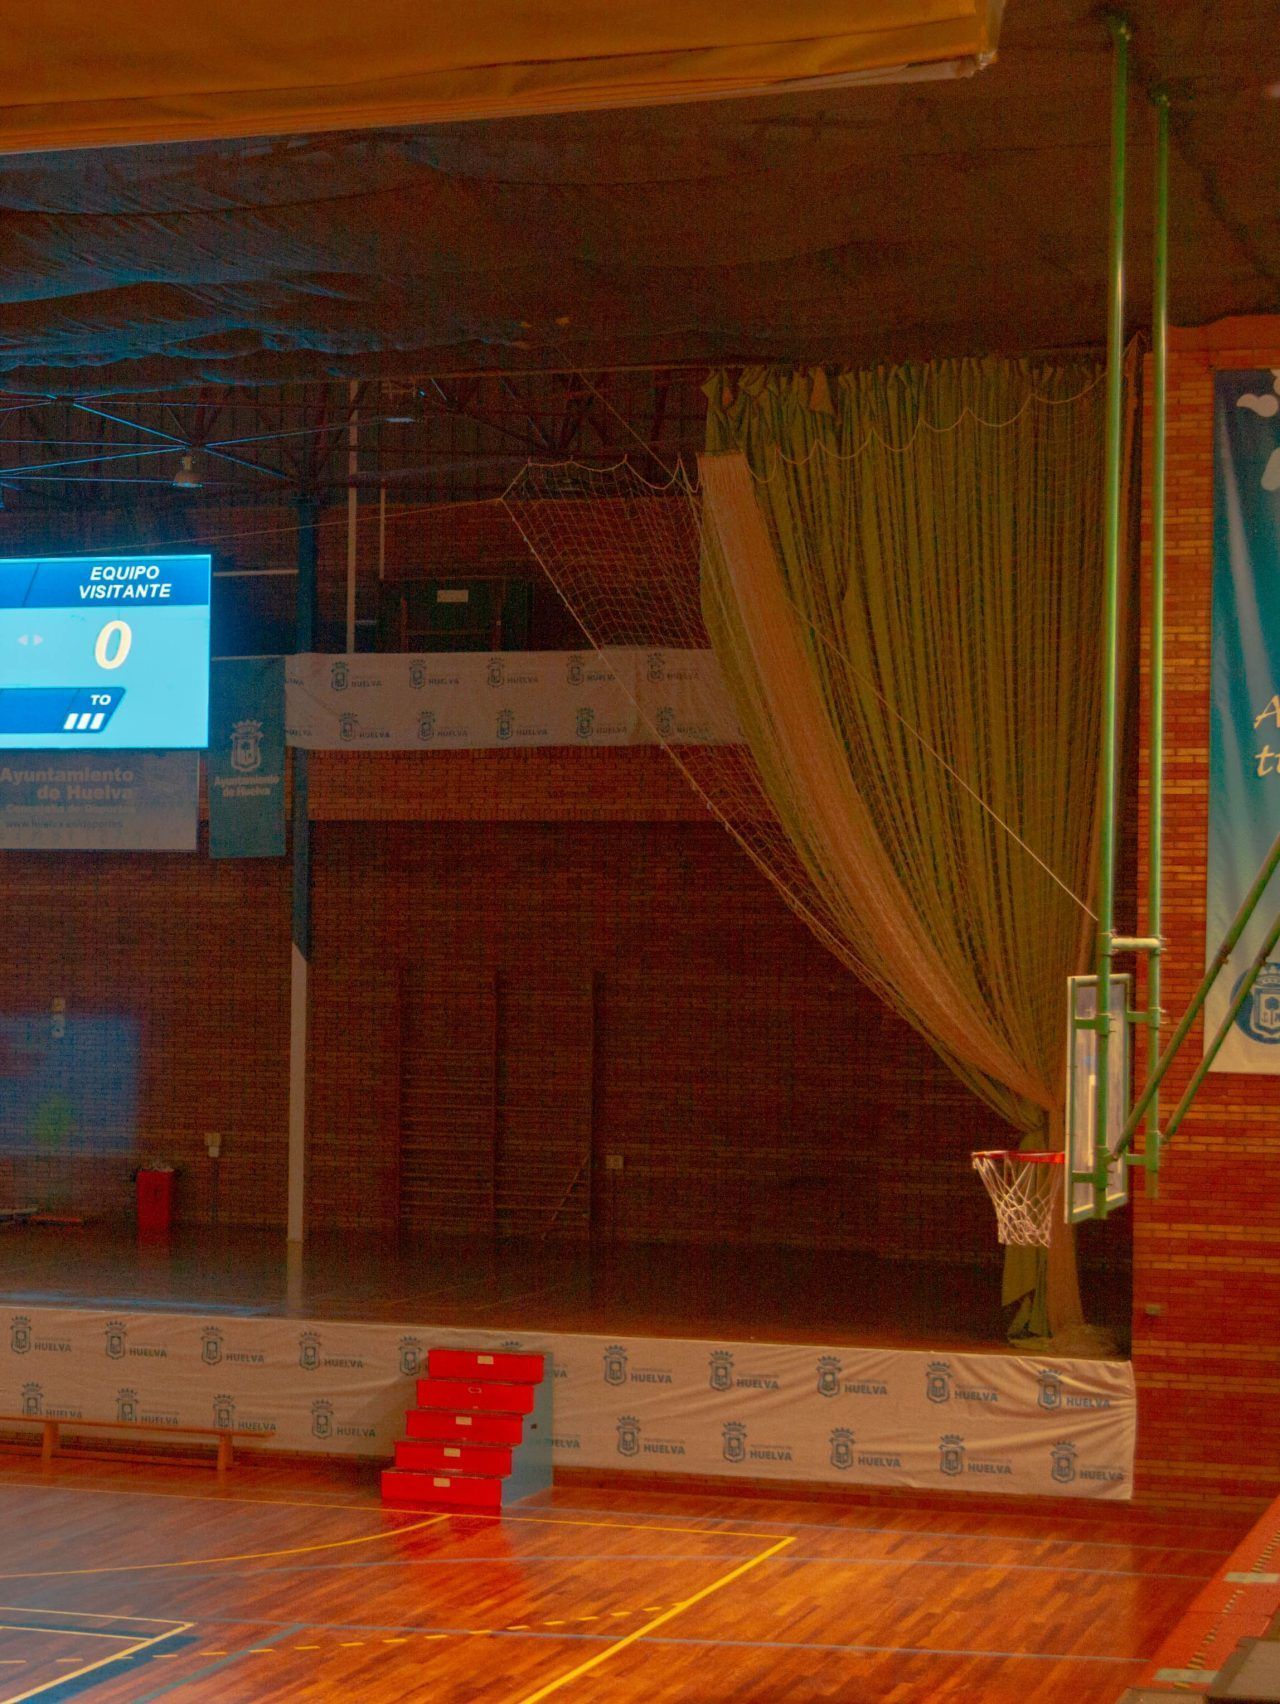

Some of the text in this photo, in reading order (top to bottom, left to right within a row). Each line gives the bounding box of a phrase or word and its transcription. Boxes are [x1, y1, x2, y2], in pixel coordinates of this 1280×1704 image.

[90, 565, 160, 580] EQUIPO
[79, 583, 172, 599] VISITANTE
[94, 620, 132, 669] 0
[90, 694, 112, 706] TO
[0, 767, 134, 785] Ayuntamiento
[37, 785, 134, 800] de Huelva
[34, 1342, 72, 1353] HUELVA
[129, 1348, 167, 1359] HUELVA
[226, 1353, 265, 1364] HUELVA
[324, 1358, 364, 1369] HUELVA
[631, 1373, 672, 1384] HUELVA
[736, 1378, 780, 1390] HUELVA
[845, 1384, 888, 1396] HUELVA
[954, 1390, 999, 1402] HUELVA
[1066, 1396, 1111, 1409] HUELVA
[237, 1420, 277, 1432] HUELVA
[336, 1426, 376, 1439] HUELVA
[643, 1443, 686, 1455] HUELVA
[750, 1450, 793, 1461] HUELVA
[858, 1455, 902, 1468] HUELVA
[968, 1463, 1012, 1475] HUELVA
[1079, 1469, 1125, 1482] HUELVA
